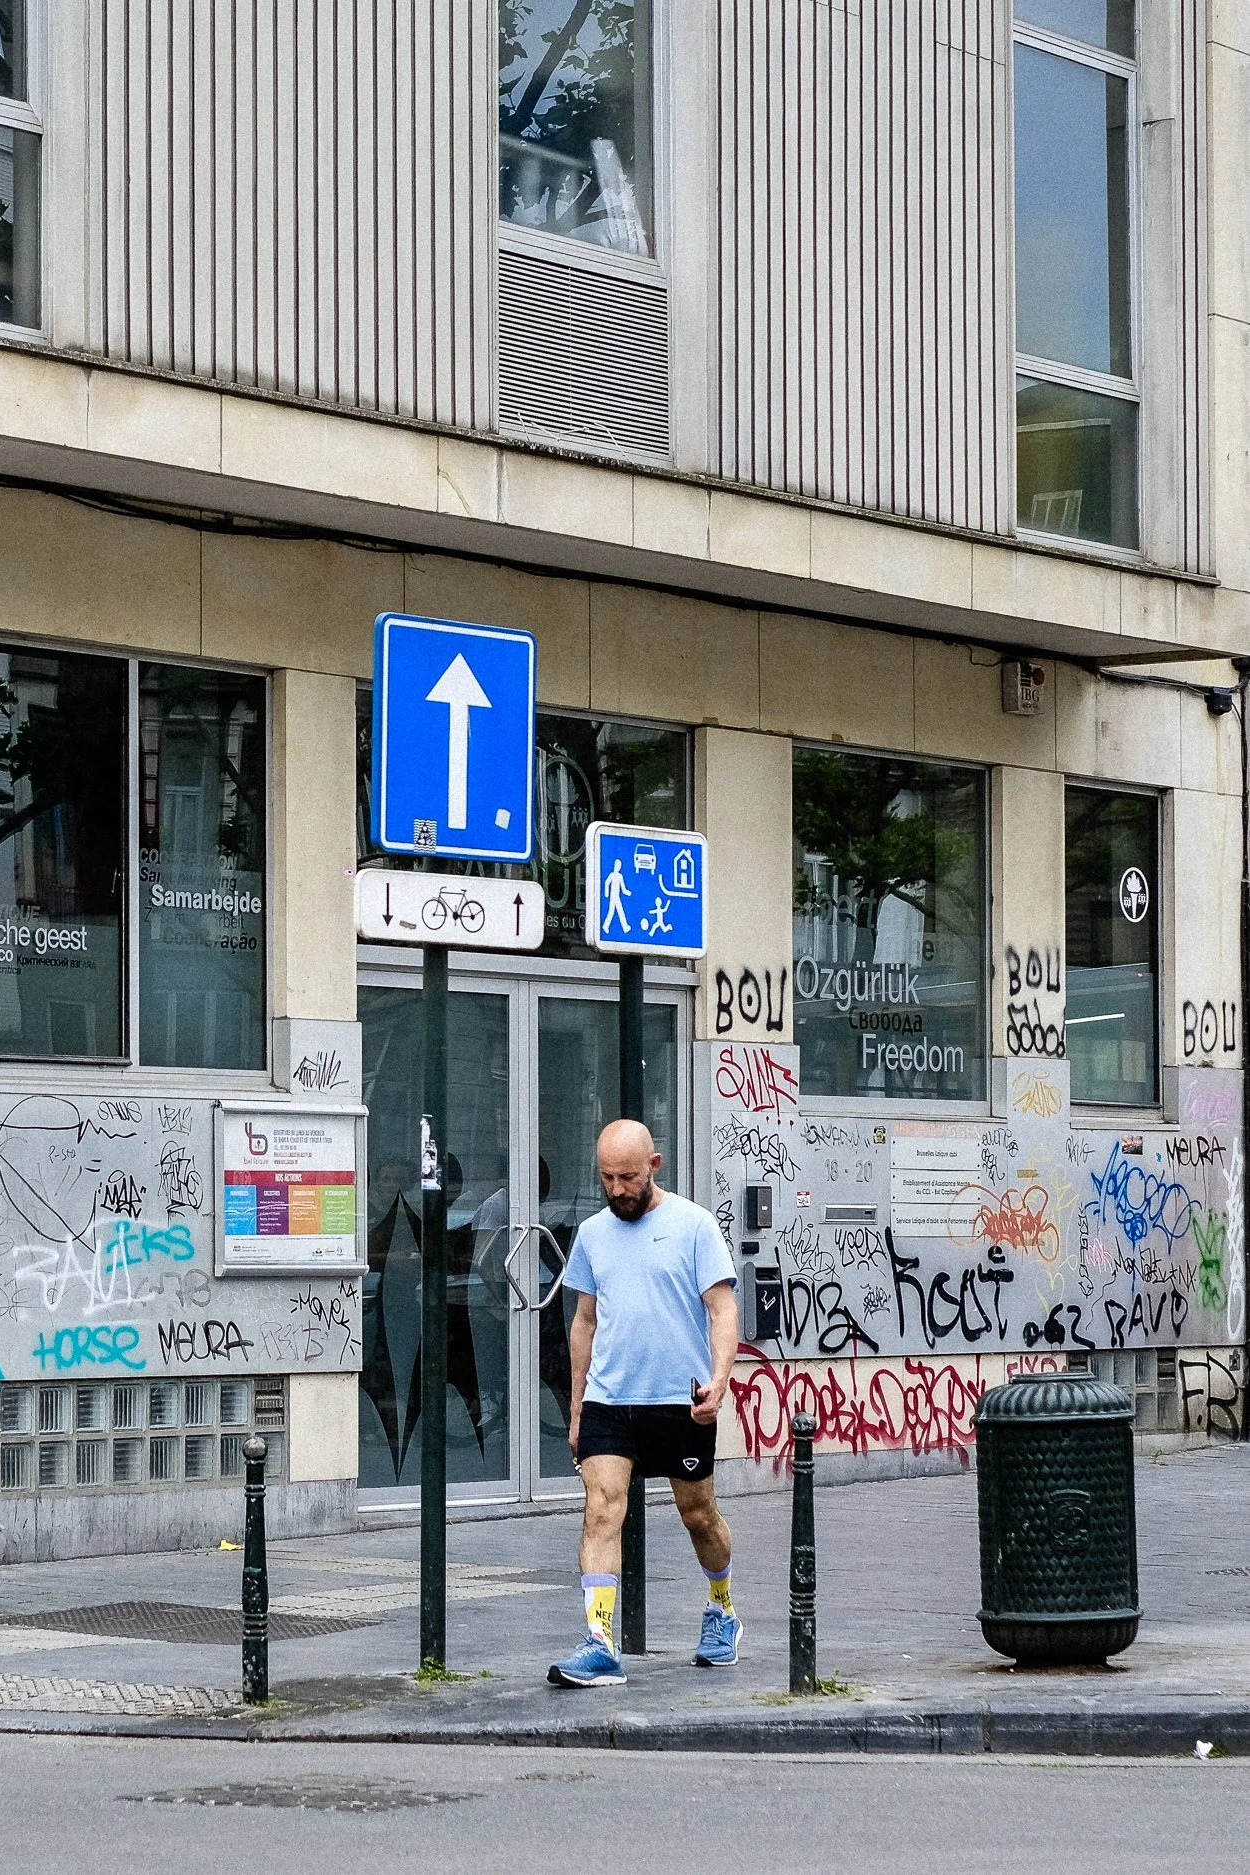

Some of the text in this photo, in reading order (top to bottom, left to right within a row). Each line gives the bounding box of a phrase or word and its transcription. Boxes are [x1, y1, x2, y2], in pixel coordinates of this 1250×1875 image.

[151, 884, 262, 916] Samarbejde
[35, 926, 88, 955] geest
[862, 1033, 964, 1073] Freedom
